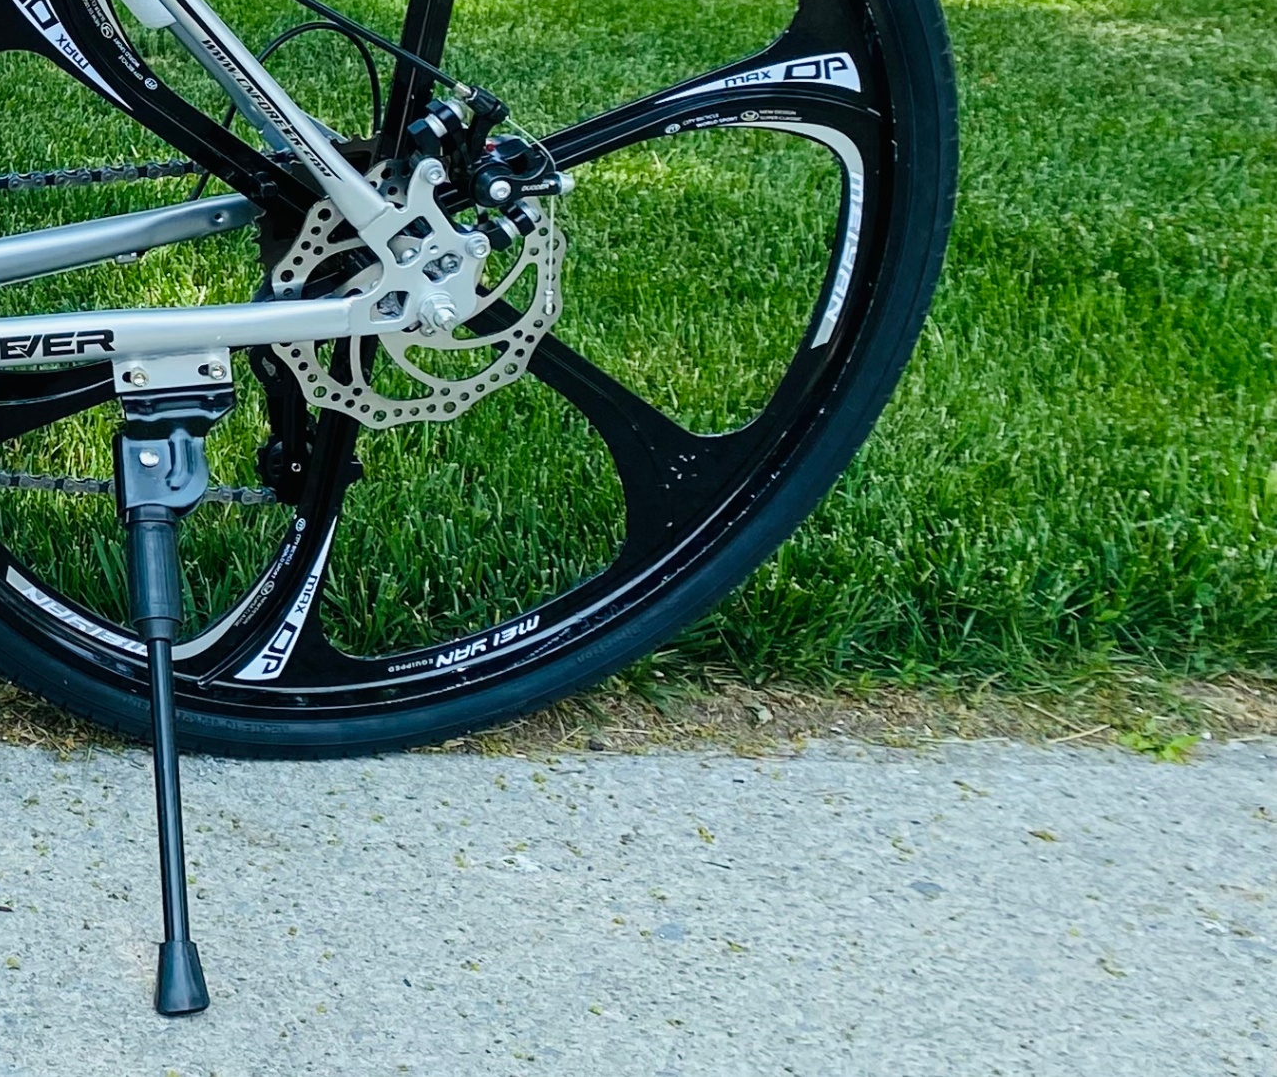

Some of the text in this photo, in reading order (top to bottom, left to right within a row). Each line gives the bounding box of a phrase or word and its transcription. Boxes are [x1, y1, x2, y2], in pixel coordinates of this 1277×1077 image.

[388, 615, 540, 672] MEI YAN EQUIPPED
